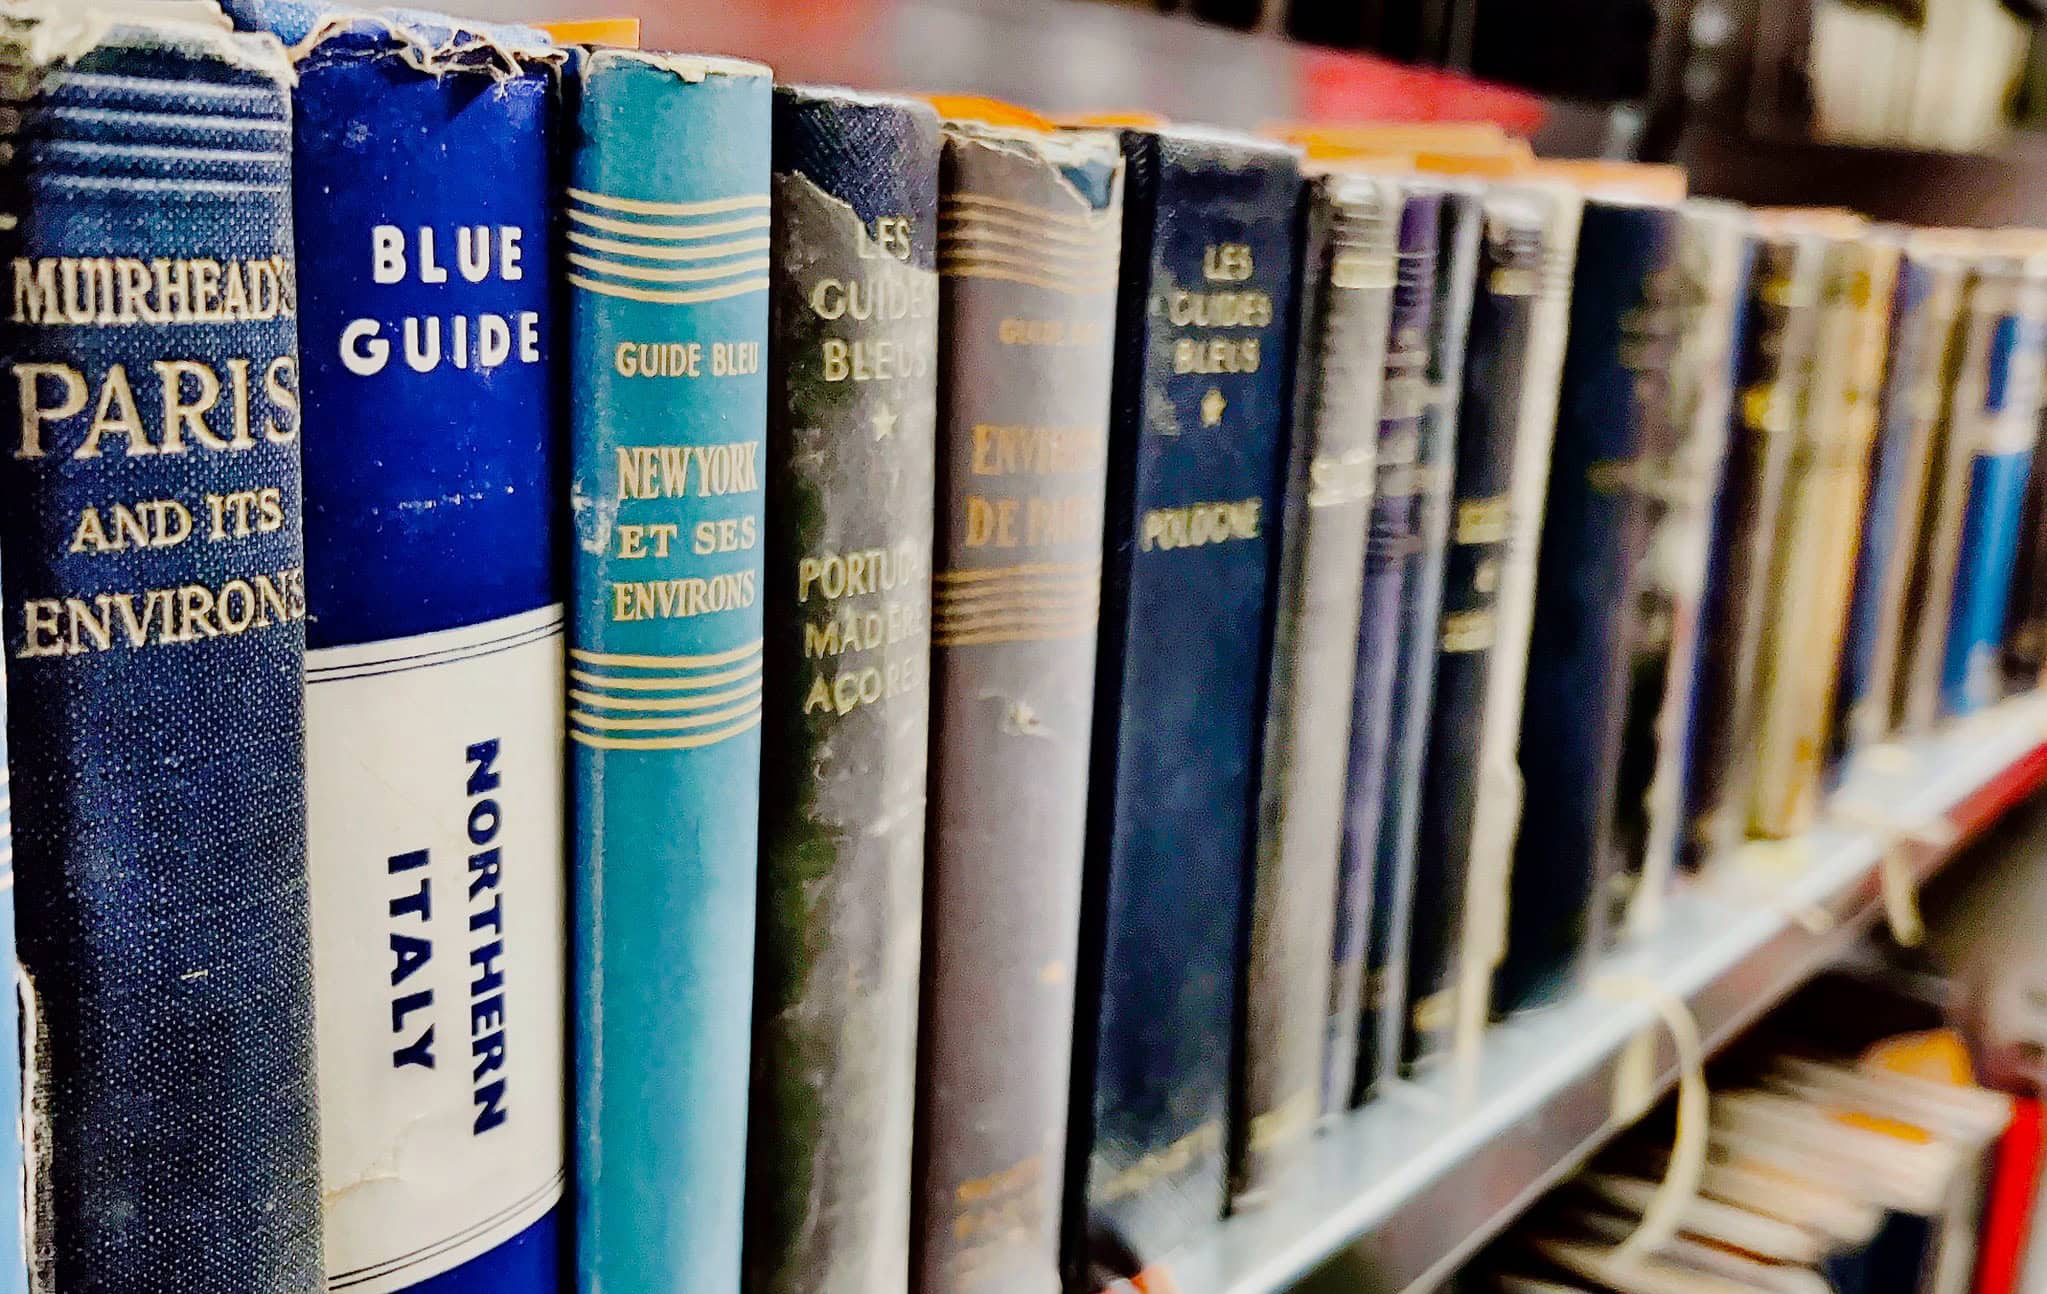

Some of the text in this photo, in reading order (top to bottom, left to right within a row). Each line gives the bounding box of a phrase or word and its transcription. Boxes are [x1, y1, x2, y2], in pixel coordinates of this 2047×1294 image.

[373, 225, 523, 284] BLUE
[857, 215, 912, 262] LES
[340, 311, 540, 377] GUIDE
[616, 341, 759, 378] GUIDE BLEU
[11, 355, 300, 460] PARIS
[616, 441, 758, 500] NEW YORK
[70, 486, 282, 554] AND ITS
[617, 517, 757, 559] ET SES
[612, 569, 756, 623] ENVIRONS
[797, 546, 929, 603] PORTU
[388, 848, 435, 1069] ITALY
[466, 738, 507, 1136] NORTHERN
